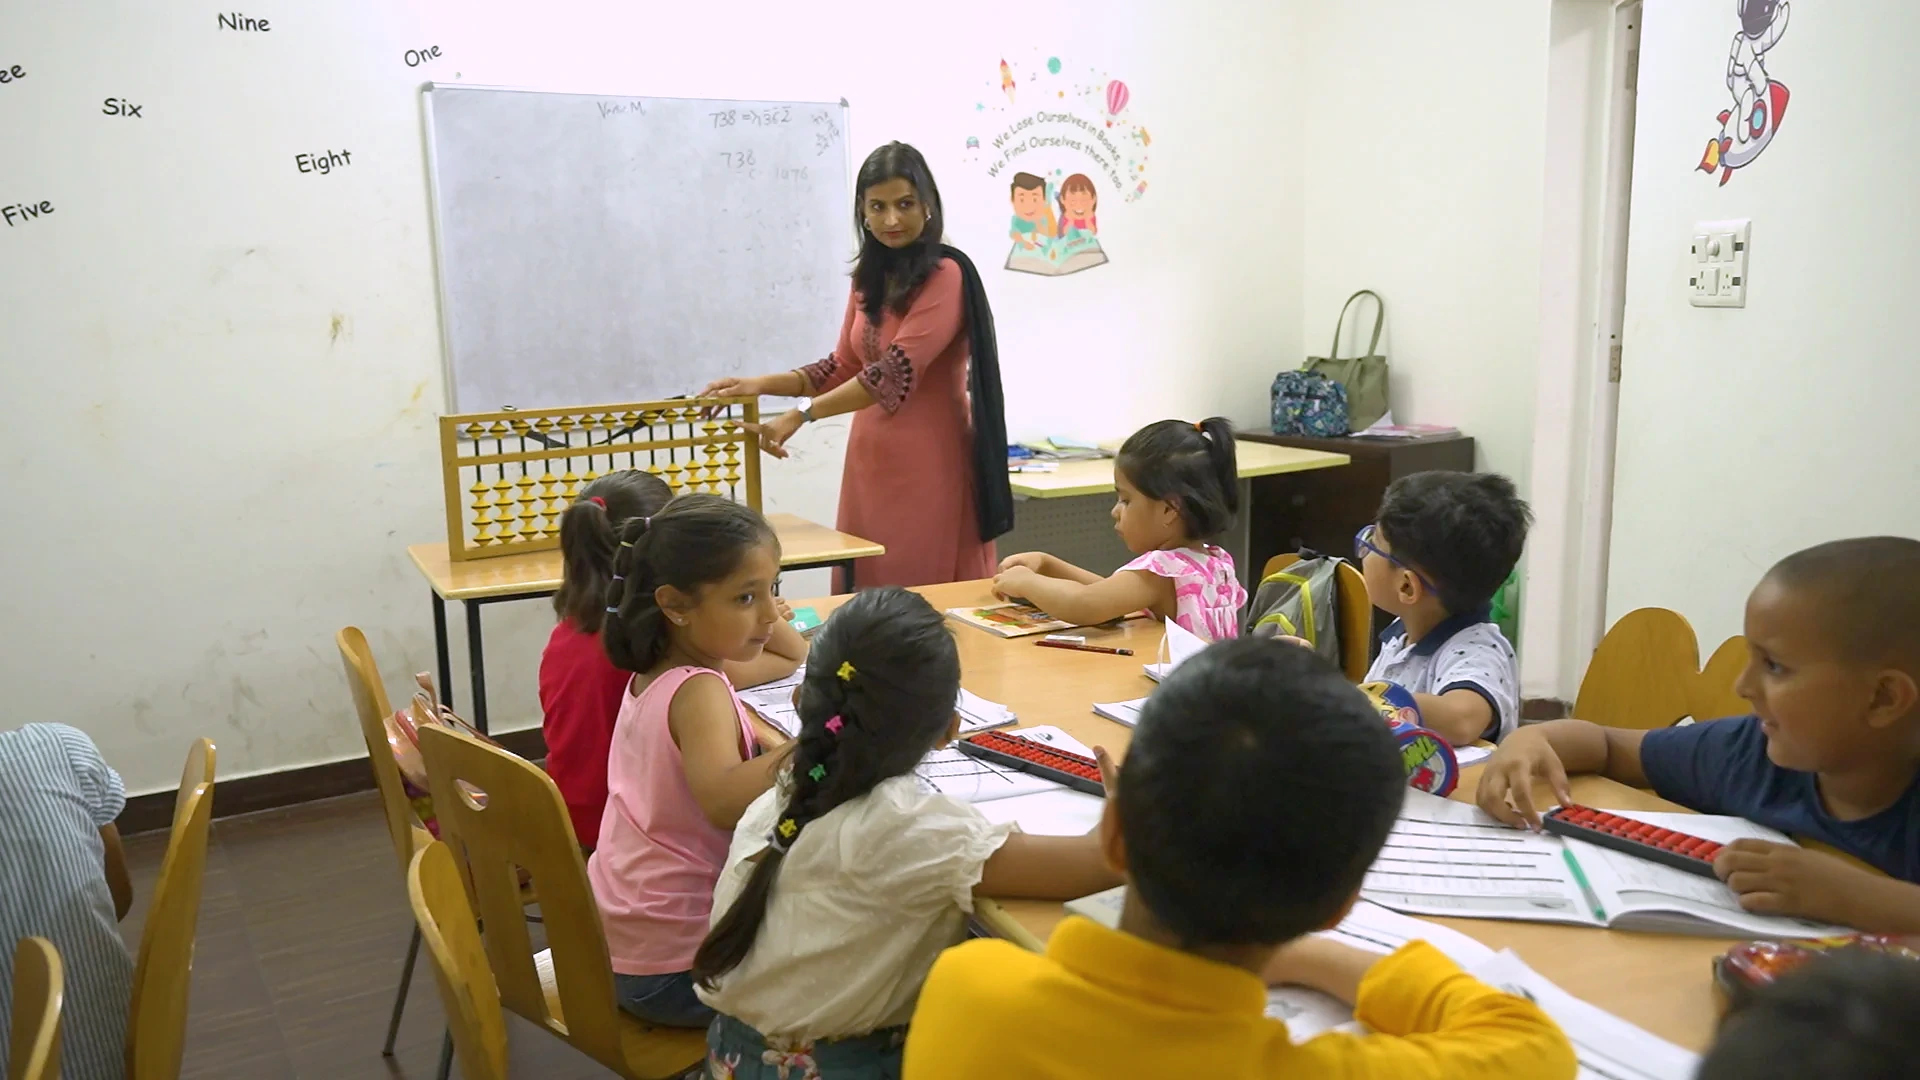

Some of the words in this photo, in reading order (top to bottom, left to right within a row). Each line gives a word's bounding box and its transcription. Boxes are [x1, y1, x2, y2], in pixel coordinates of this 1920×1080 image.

[218, 12, 271, 32] Nine
[404, 44, 443, 68] One
[102, 97, 143, 119] Six
[992, 133, 1010, 149] We
[1009, 116, 1034, 135] Lose
[1036, 111, 1088, 130] Ourselves
[1087, 124, 1098, 137] in
[295, 148, 352, 175] Eight
[987, 160, 1005, 178] We
[1003, 139, 1027, 162] Find
[1029, 134, 1082, 151] Ourselves
[1084, 144, 1109, 171] there
[1, 199, 55, 227] Five
